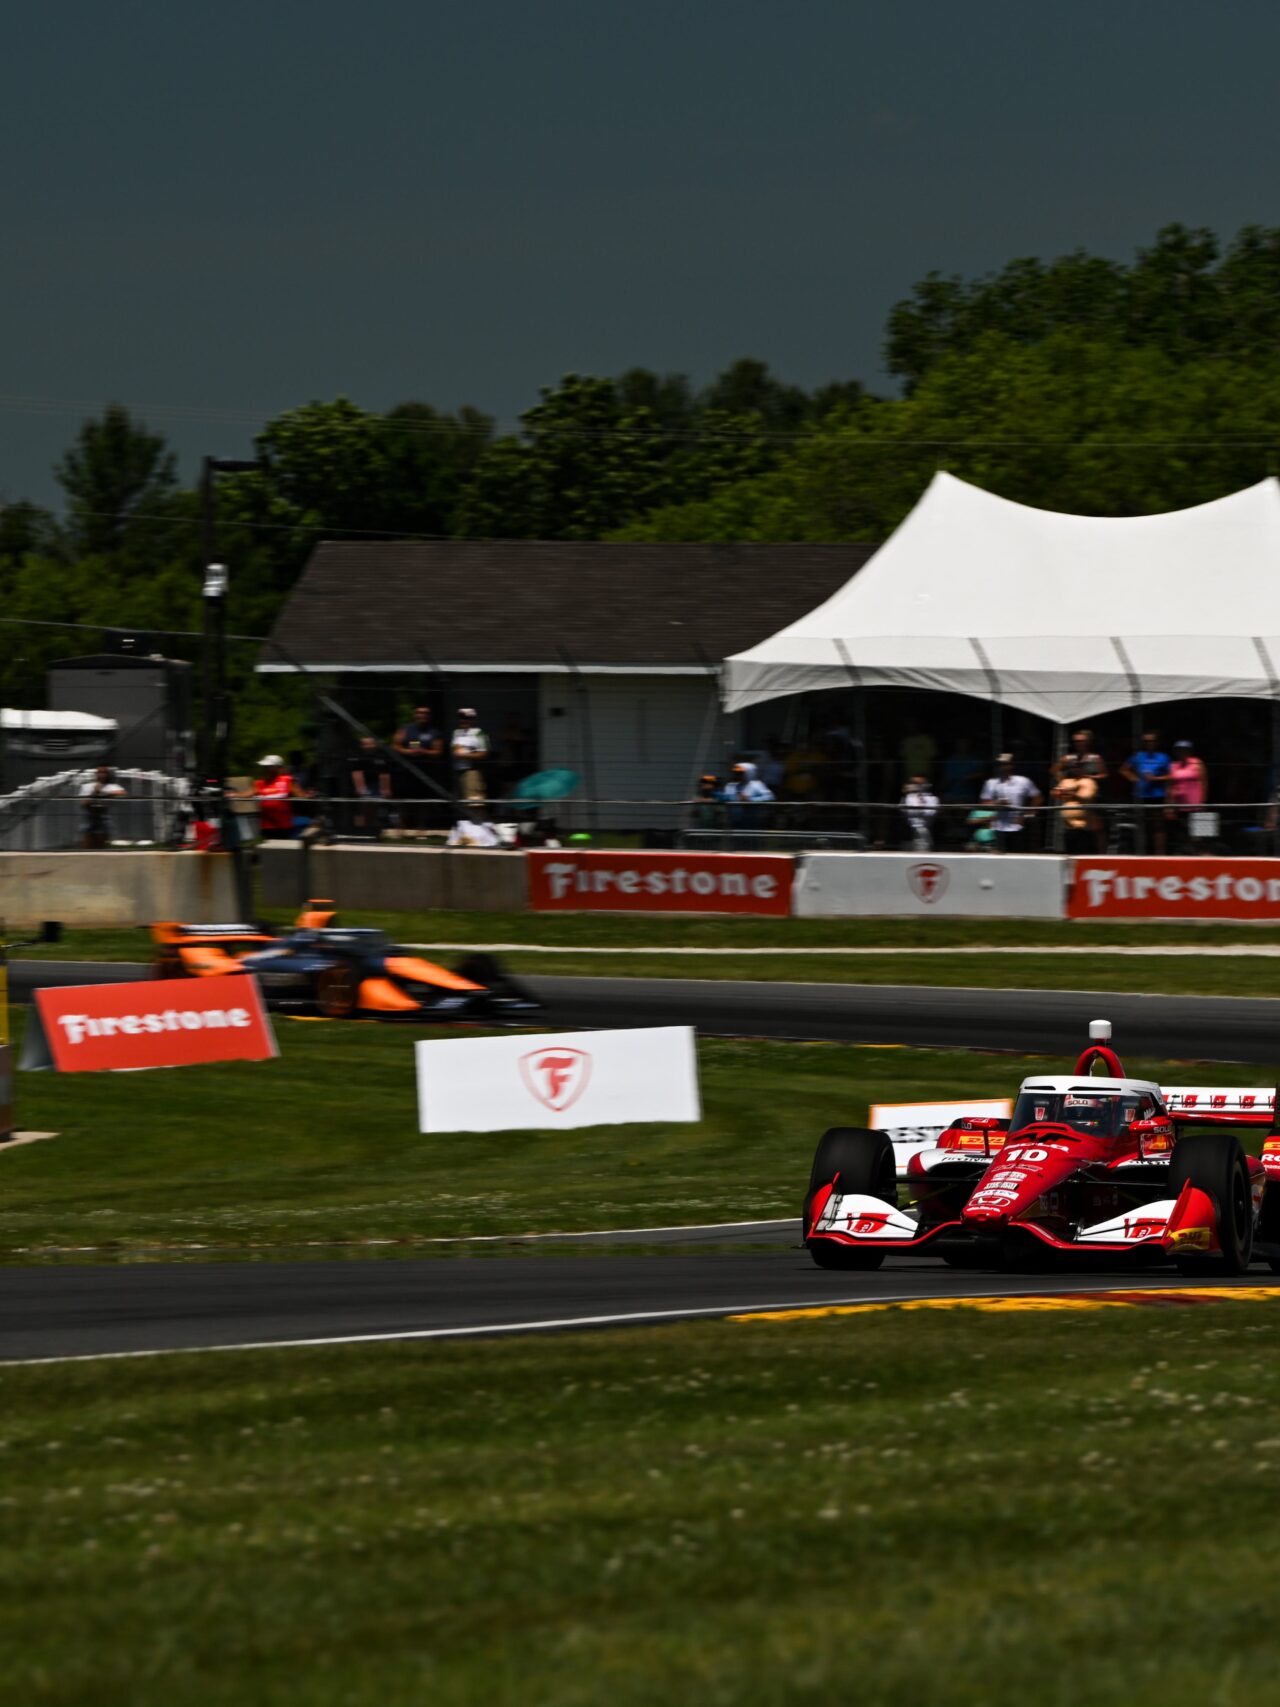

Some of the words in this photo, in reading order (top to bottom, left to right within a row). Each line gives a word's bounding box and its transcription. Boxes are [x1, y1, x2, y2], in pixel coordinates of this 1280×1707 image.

[543, 862, 778, 900] Firestone
[58, 1007, 251, 1044] Firestone
[536, 1056, 577, 1100] F
[1005, 1149, 1048, 1162] 10
